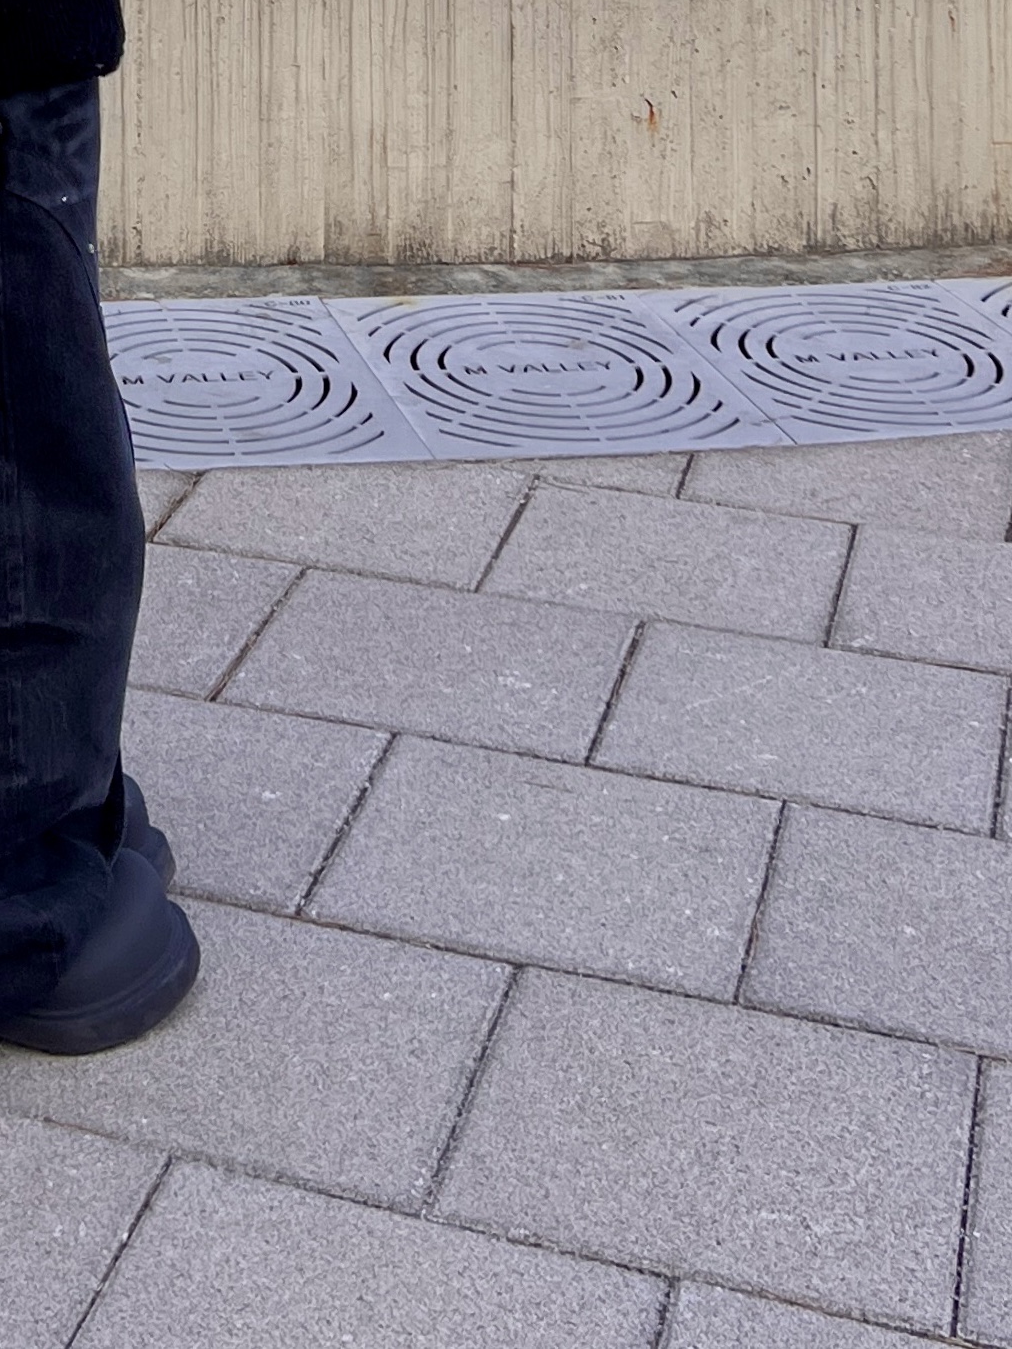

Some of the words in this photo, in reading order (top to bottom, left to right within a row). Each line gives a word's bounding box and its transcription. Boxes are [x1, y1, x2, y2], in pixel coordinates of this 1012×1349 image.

[794, 354, 820, 363] M
[826, 349, 939, 361] VALLEY
[463, 365, 488, 375] M
[497, 361, 611, 374] VALLEY
[121, 375, 144, 385] M
[156, 370, 275, 383] VALLEY
